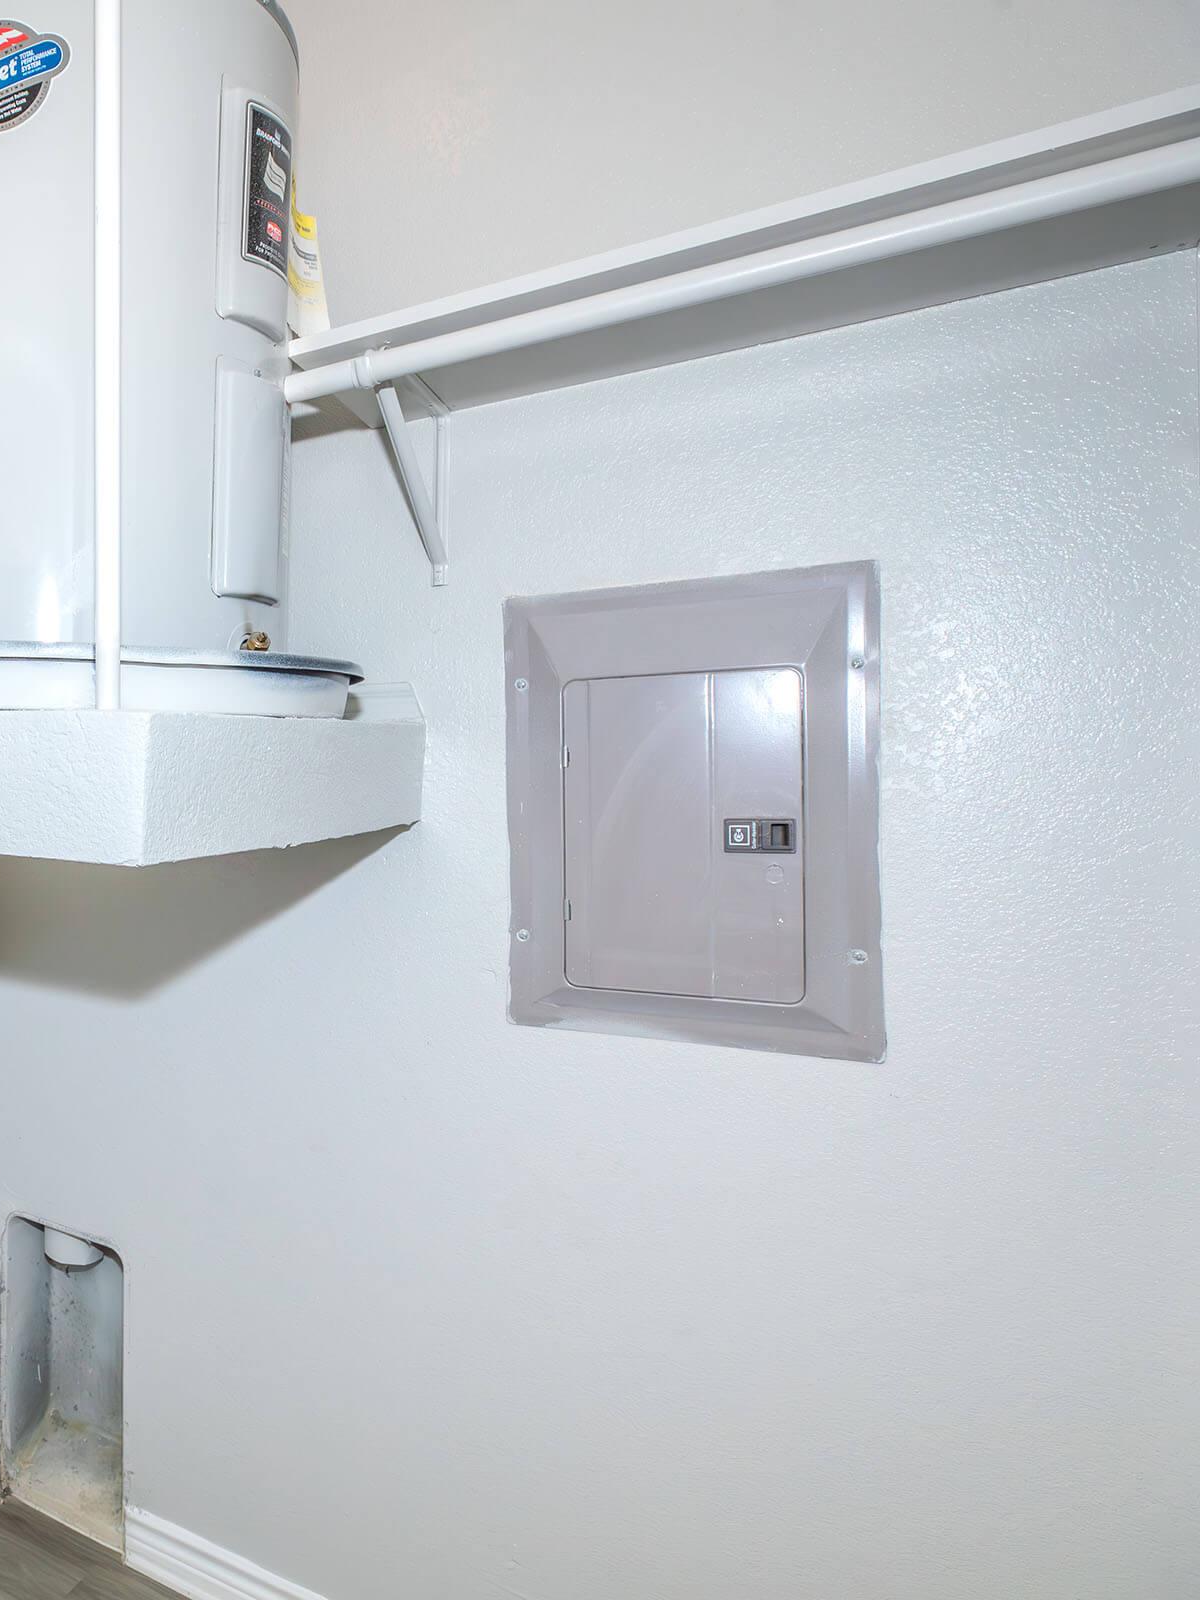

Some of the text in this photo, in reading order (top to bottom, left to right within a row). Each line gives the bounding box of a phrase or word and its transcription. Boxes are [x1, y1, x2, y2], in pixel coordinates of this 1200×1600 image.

[19, 49, 35, 60] TOTAL
[20, 47, 57, 67] PERFORMANCE
[20, 59, 41, 73] SYSTEM
